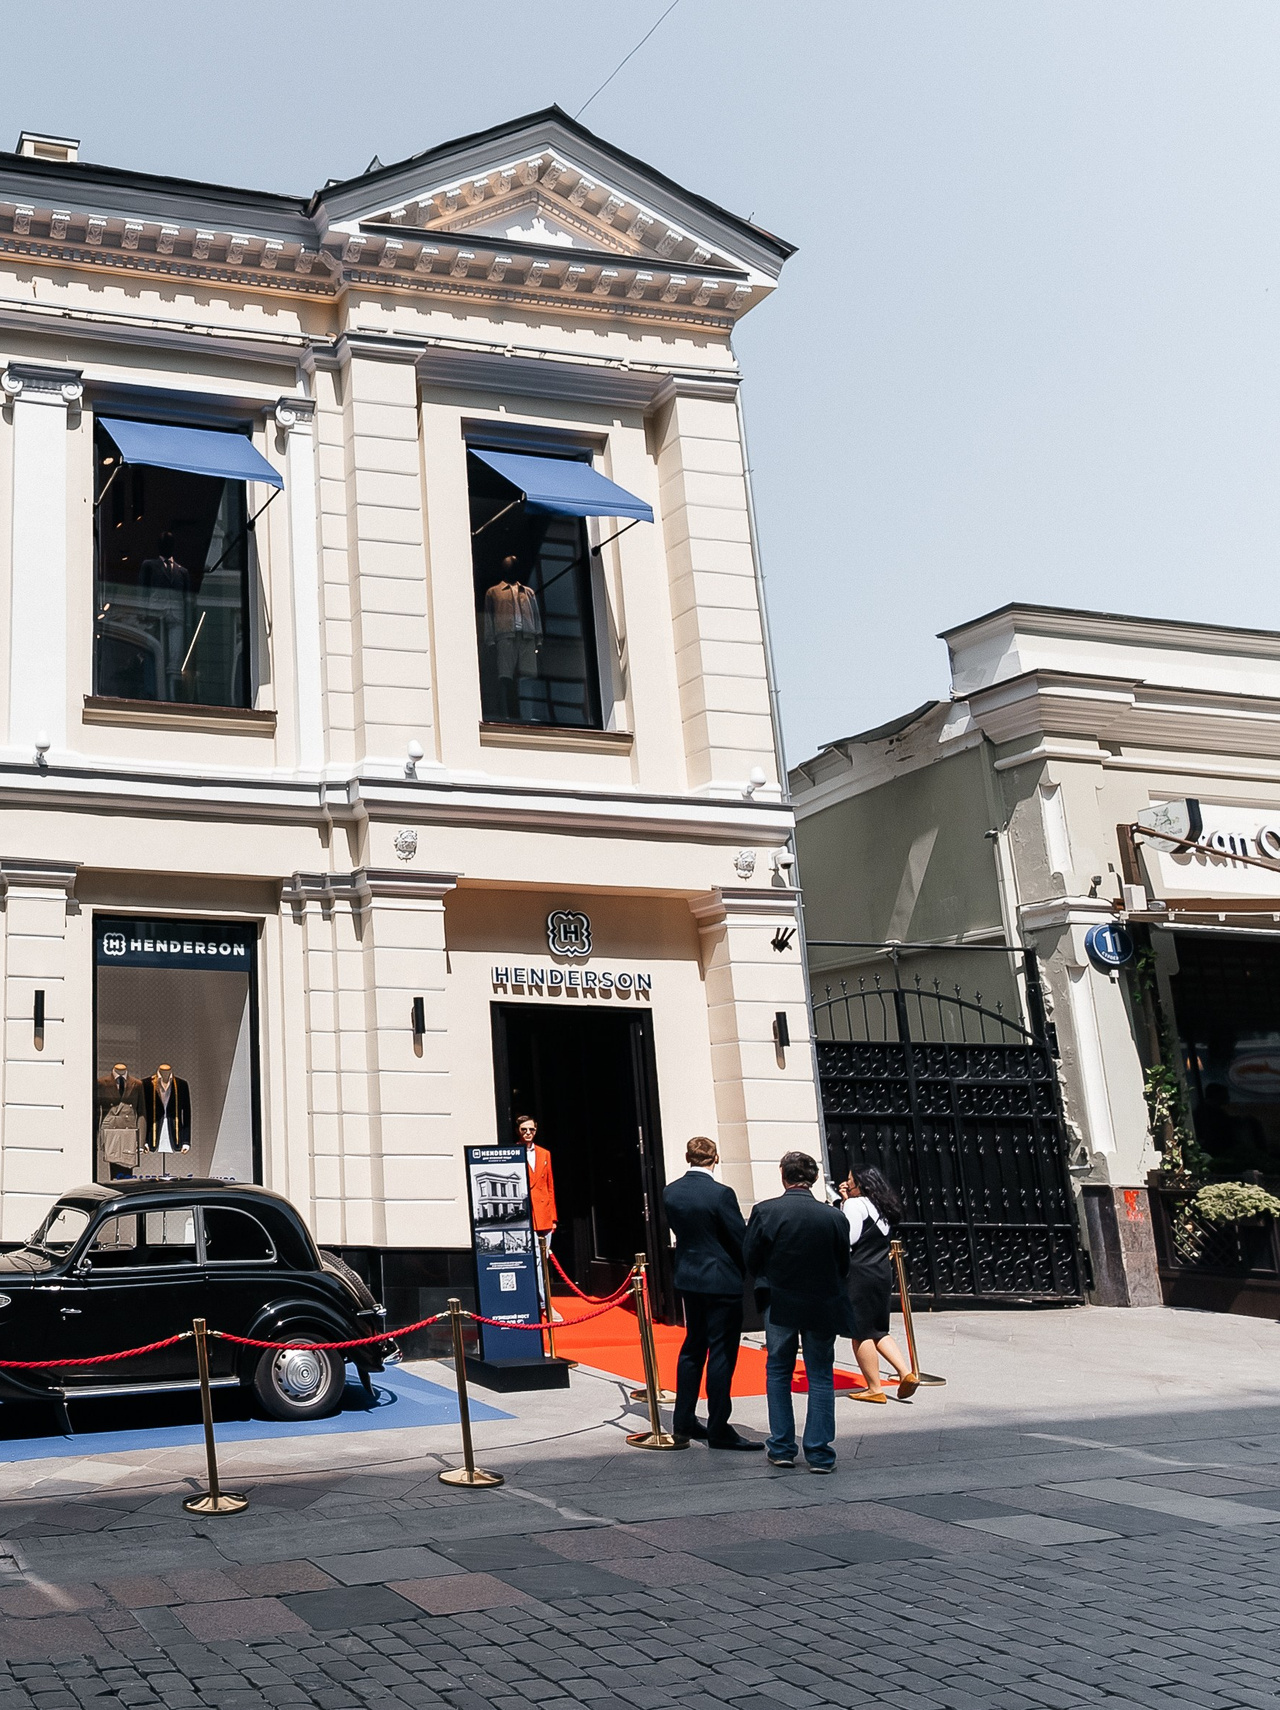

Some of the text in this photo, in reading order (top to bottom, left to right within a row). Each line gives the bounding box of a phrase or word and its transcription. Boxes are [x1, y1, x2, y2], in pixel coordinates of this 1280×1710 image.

[130, 939, 246, 956] HENDERSON
[1102, 930, 1122, 953] 11
[493, 966, 653, 990] HENDERSON
[481, 1149, 521, 1157] HENDERSON
